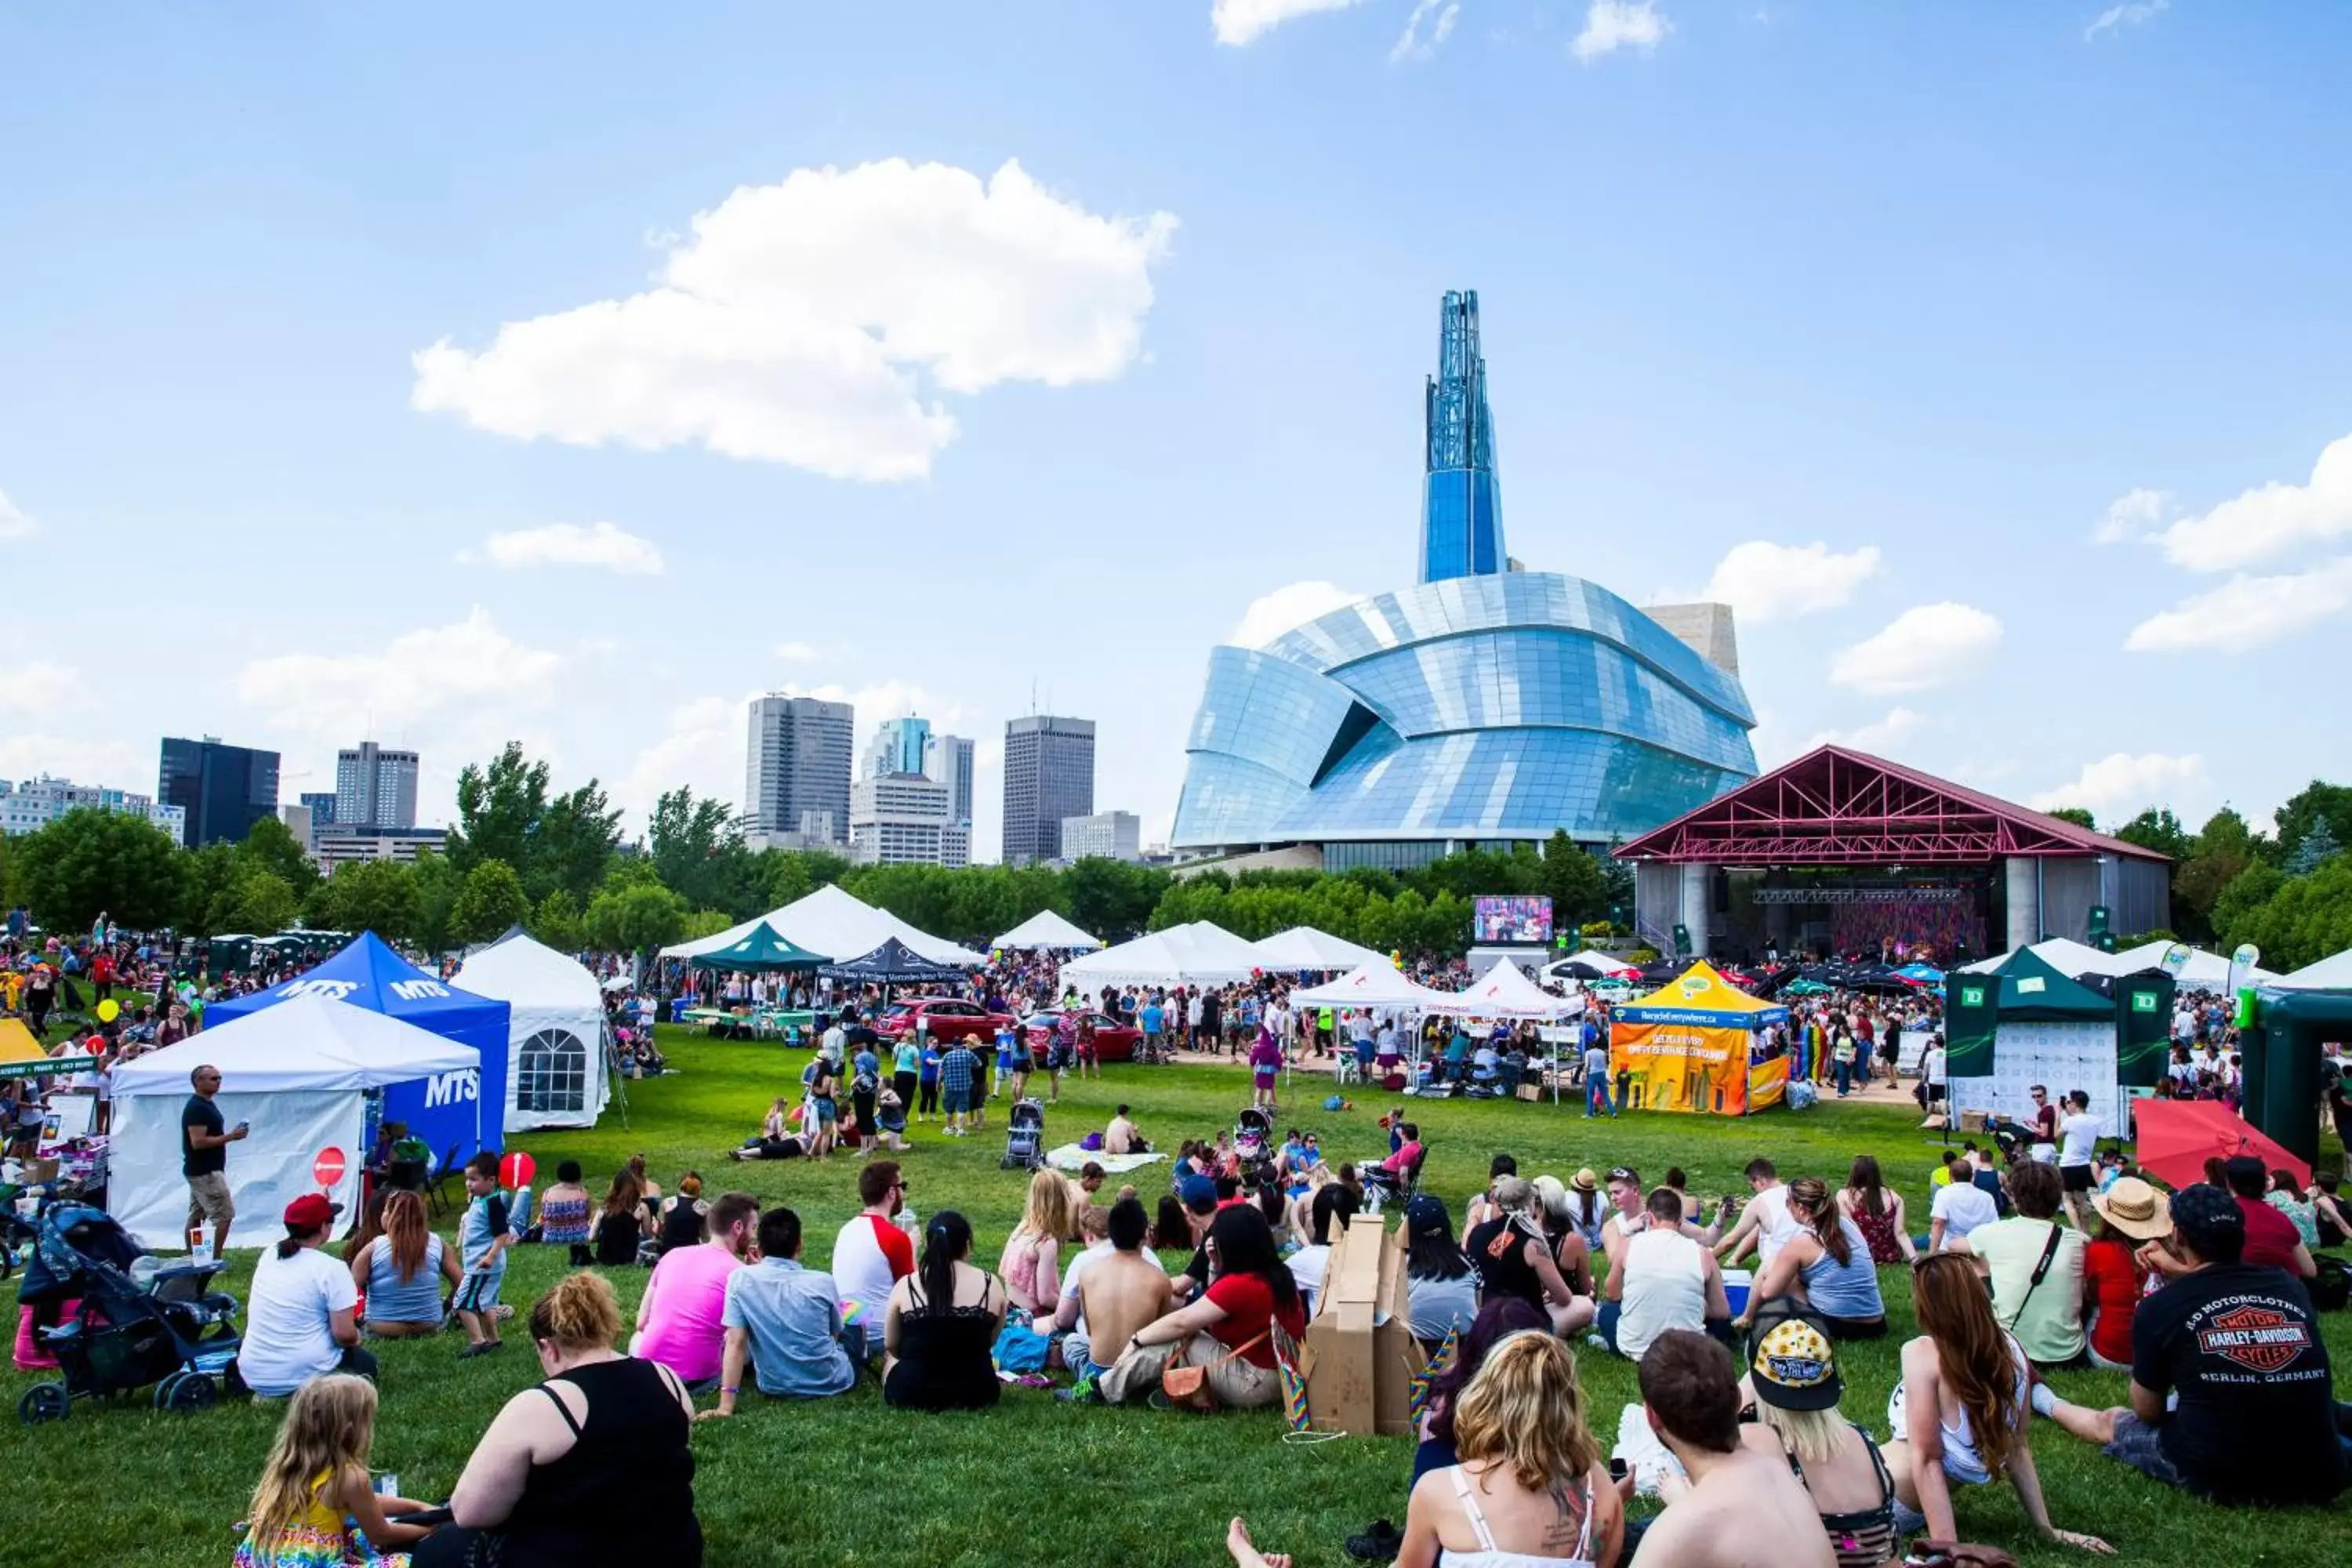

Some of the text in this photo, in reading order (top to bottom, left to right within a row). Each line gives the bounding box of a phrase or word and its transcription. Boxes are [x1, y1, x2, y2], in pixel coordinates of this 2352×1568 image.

[276, 980, 358, 1000] MTS
[390, 980, 451, 1000] MTS
[1964, 989, 1983, 1004] TD
[2134, 995, 2155, 1008] TD
[424, 1069, 477, 1109] MTS
[2201, 1294, 2307, 1319] MOTORCLOTHES
[2206, 1327, 2304, 1347] HARLEY-DAVIDSON
[2236, 1346, 2290, 1366] CYCLES
[2199, 1369, 2325, 1384] BERLIN, GERMANY
